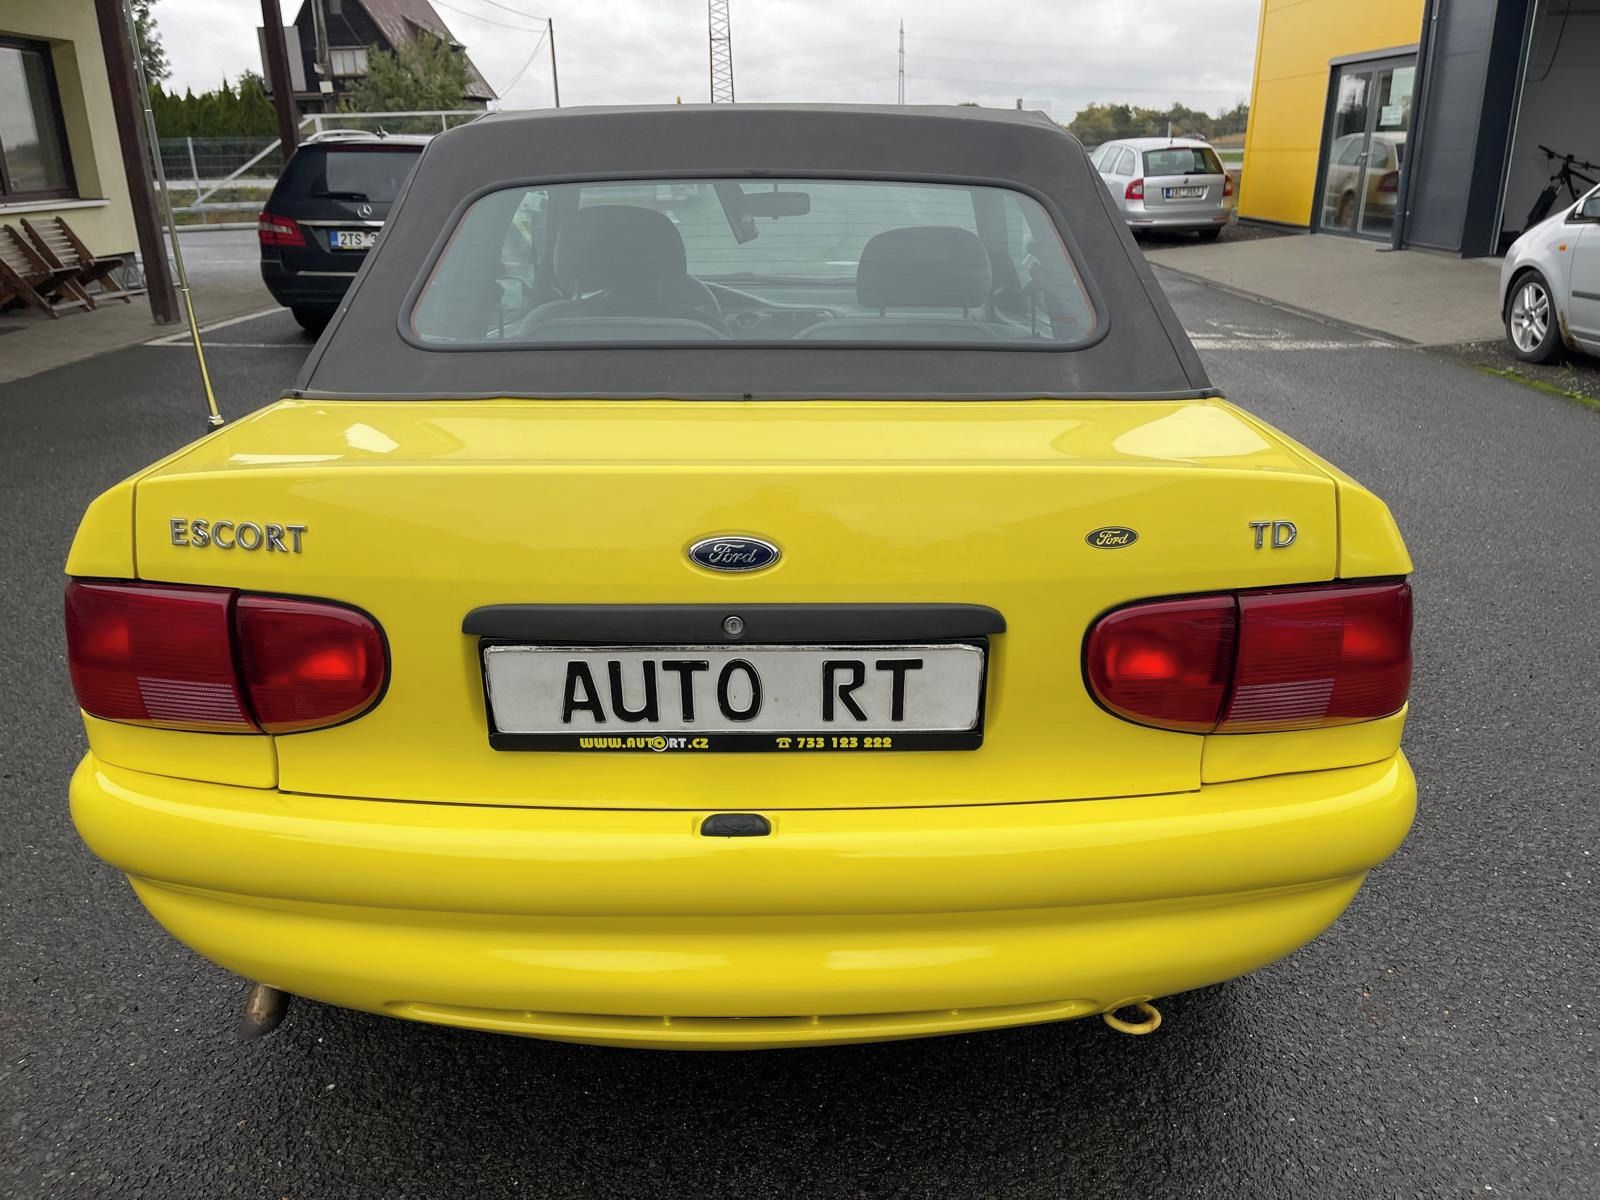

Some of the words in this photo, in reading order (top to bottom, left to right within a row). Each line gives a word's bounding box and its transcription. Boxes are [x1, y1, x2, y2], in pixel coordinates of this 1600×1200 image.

[340, 233, 362, 245] 2TS
[170, 518, 308, 553] ESCORT
[1096, 530, 1129, 545] Ford
[1248, 520, 1297, 549] TD
[708, 543, 758, 564] Ford
[560, 658, 764, 724] AUTO
[821, 658, 924, 722] RT
[796, 737, 825, 748] 733
[831, 737, 858, 748] 123
[863, 736, 892, 748] 222
